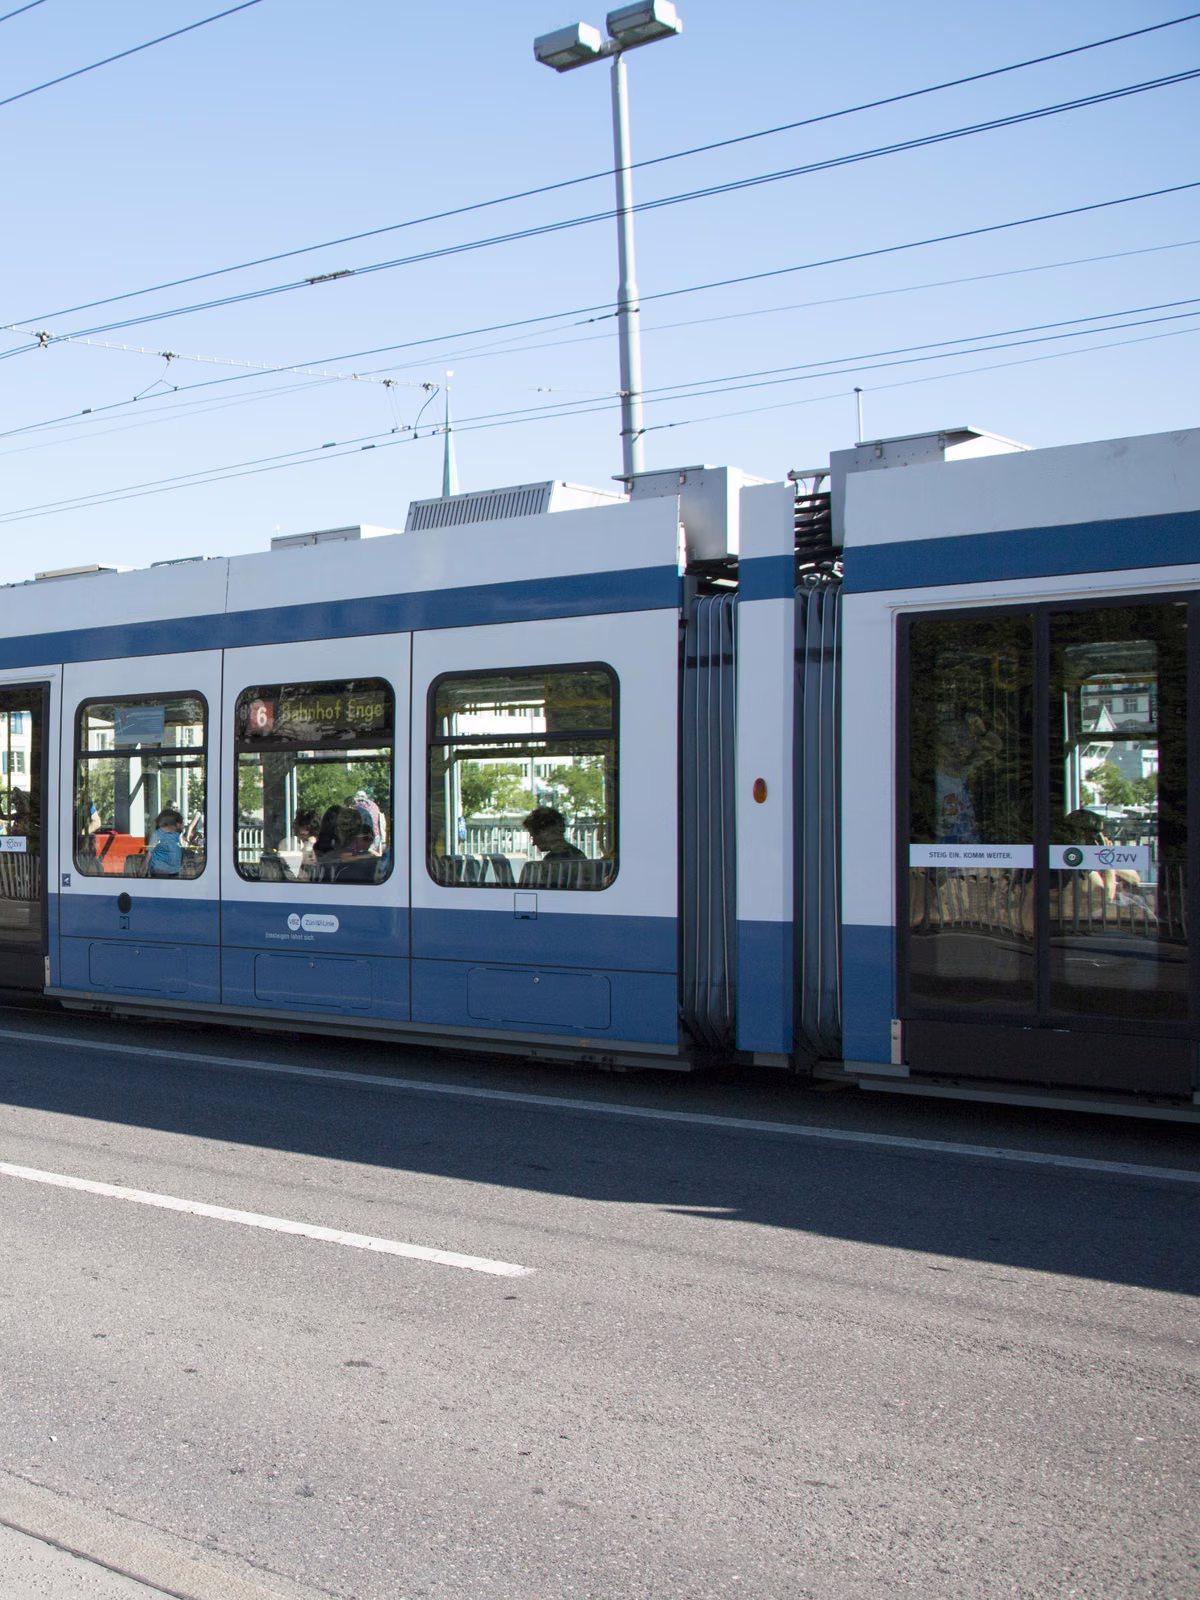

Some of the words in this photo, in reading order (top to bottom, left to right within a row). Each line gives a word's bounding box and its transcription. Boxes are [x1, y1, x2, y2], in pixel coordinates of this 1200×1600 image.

[256, 706, 267, 727] 6
[282, 699, 341, 721] Bahnhof
[347, 698, 384, 721] Enge
[1116, 854, 1137, 863] ZVV
